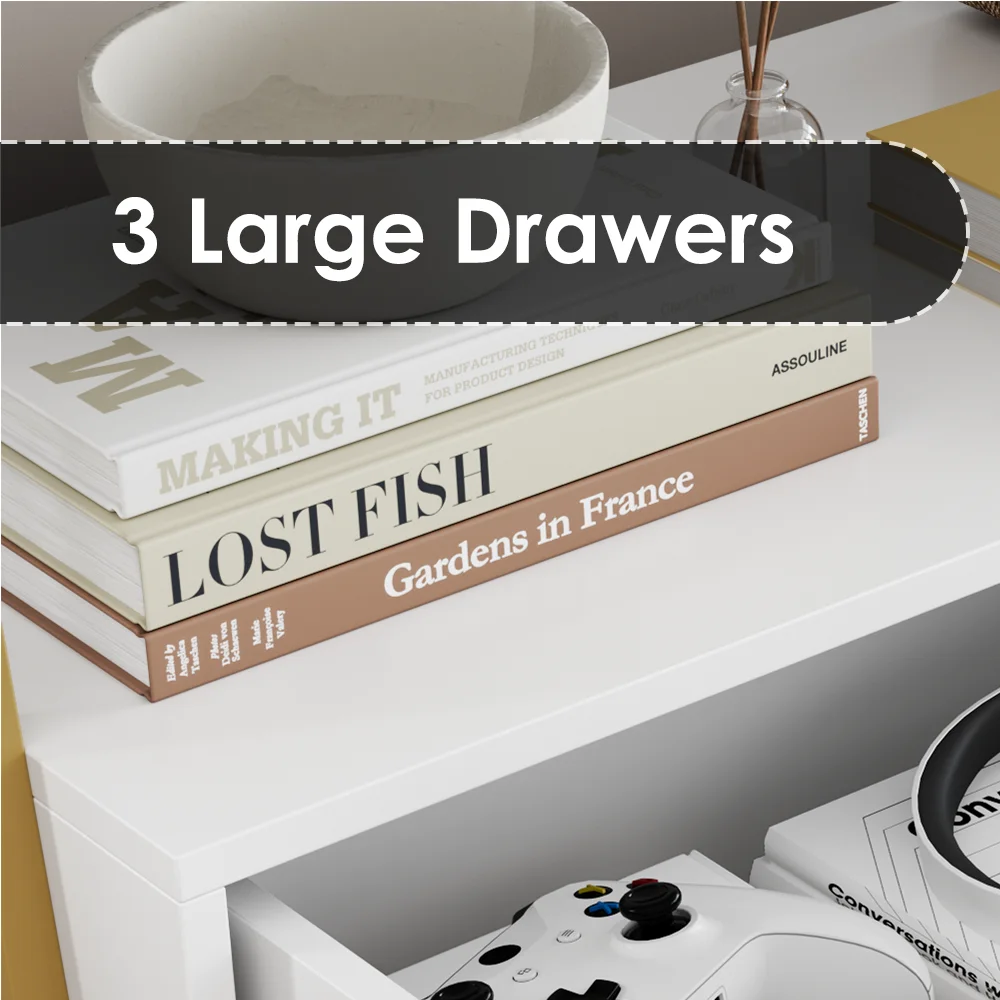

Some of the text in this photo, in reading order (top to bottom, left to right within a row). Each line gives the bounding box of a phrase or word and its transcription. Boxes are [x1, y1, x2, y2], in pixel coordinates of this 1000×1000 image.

[423, 339, 537, 386] MANUFACTURING
[424, 348, 565, 404] FOR PRODUCT DESIGN
[771, 339, 847, 377] ASSOULINE
[157, 383, 401, 494] MAKING IT
[858, 387, 868, 442] TASCHEN
[163, 443, 496, 607] LOST FISH
[384, 471, 695, 599] Gardens in France
[164, 644, 176, 654] by
[828, 883, 978, 983] Conversations
